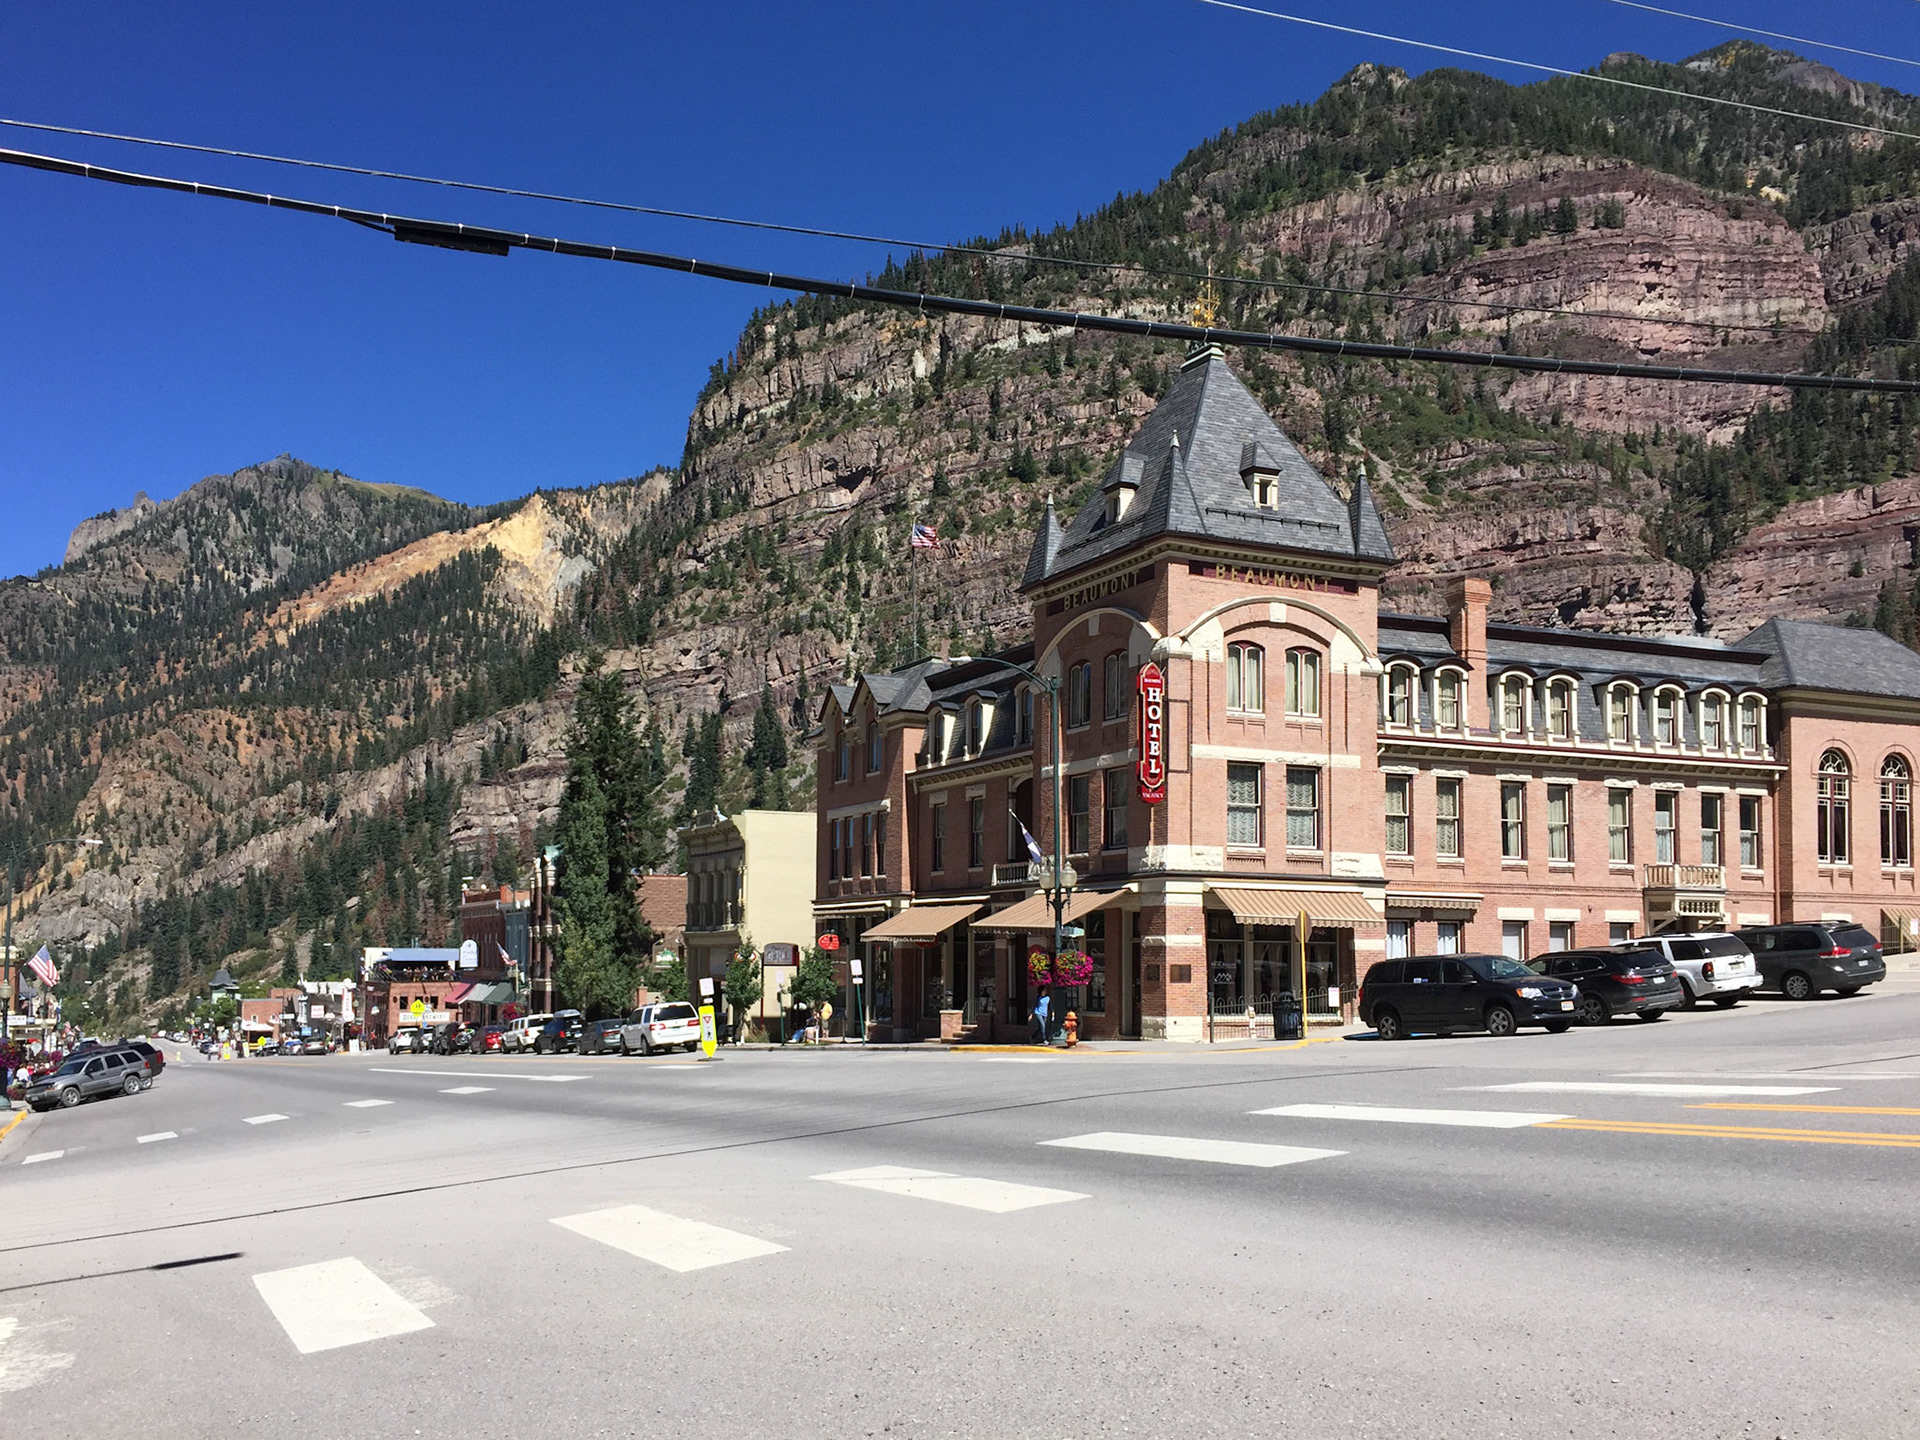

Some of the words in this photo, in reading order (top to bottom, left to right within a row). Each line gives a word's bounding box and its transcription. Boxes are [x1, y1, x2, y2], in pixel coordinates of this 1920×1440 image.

[1064, 568, 1139, 610] BEAUMONT
[1215, 563, 1331, 592] BEAUMONT
[1147, 687, 1161, 774] HOTEL
